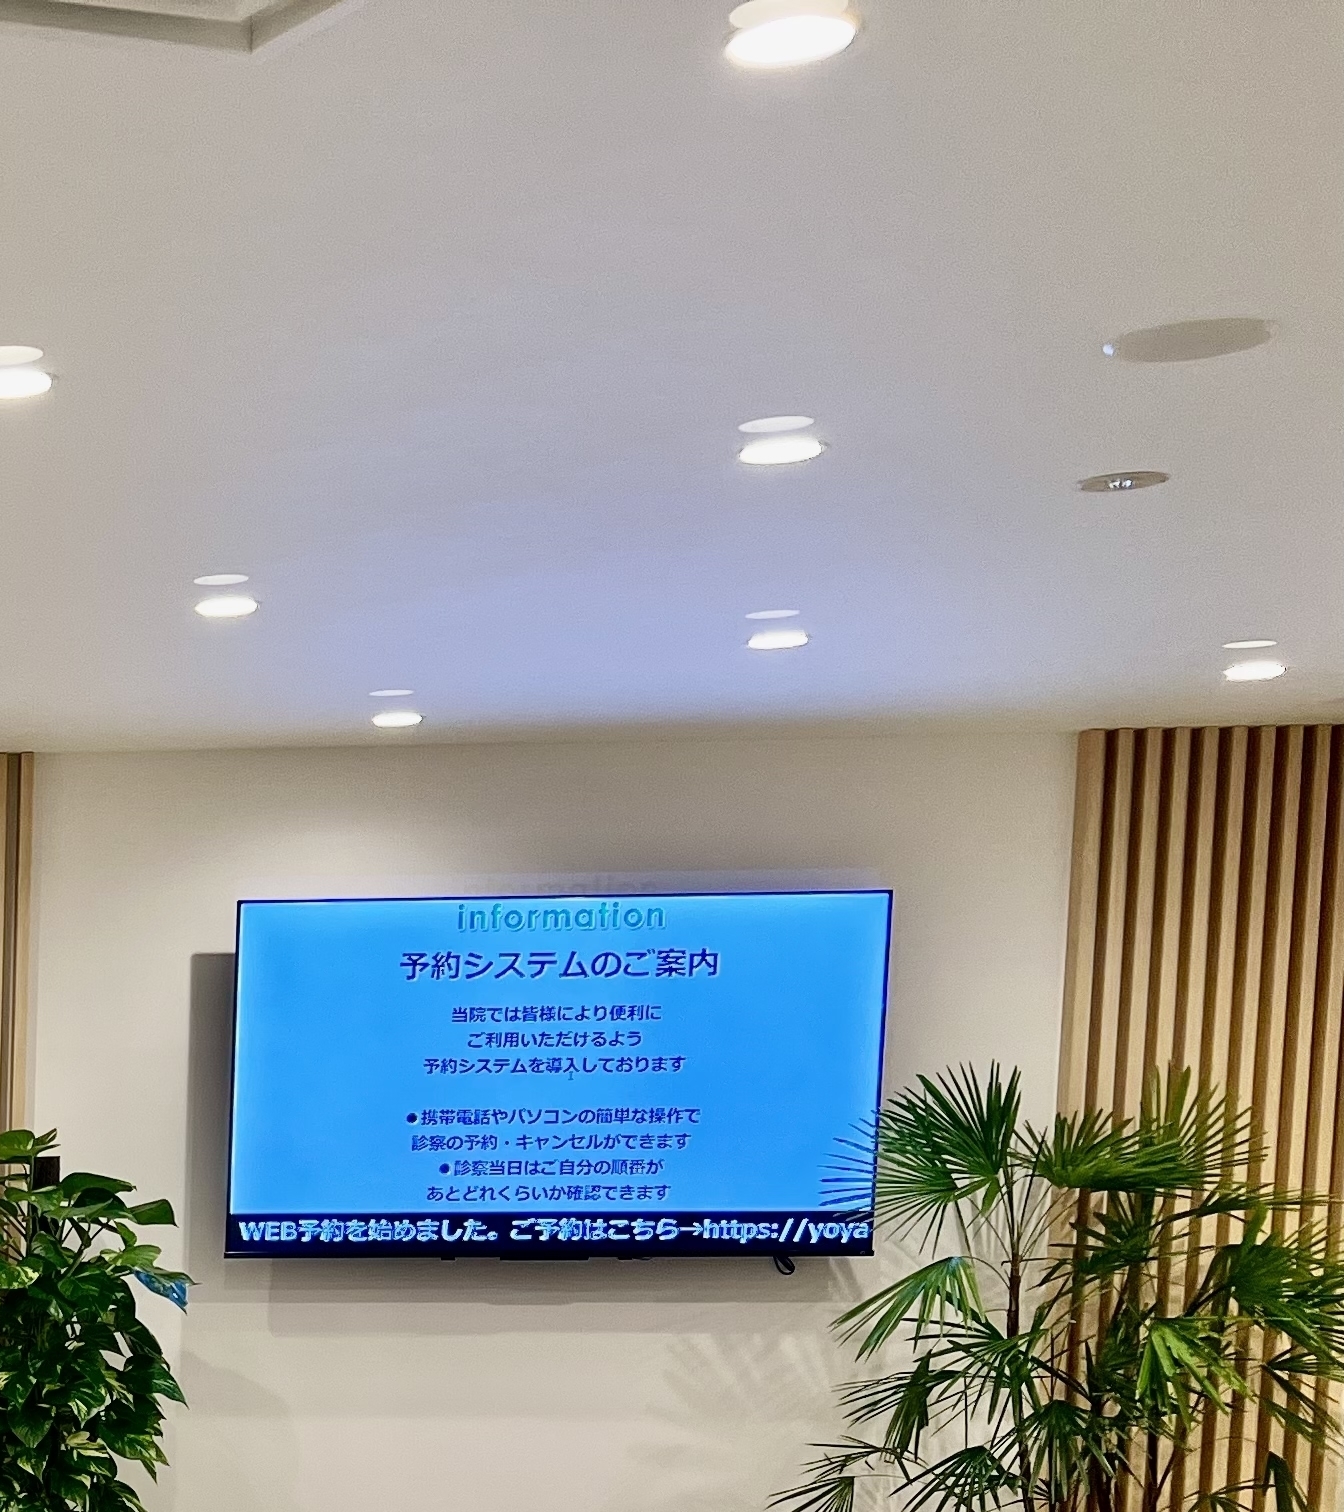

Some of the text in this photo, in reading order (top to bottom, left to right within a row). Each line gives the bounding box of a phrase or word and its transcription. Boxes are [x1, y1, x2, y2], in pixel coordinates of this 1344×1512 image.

[457, 902, 667, 932] information
[399, 947, 721, 981] 予約システムのご案内
[451, 1004, 663, 1024] 当院では皆様により便利に
[466, 1030, 643, 1048] ご利用いただけるよう
[422, 1054, 687, 1075] 予約システムを導入しております
[426, 1183, 672, 1202] あとどれくらいか確認できます
